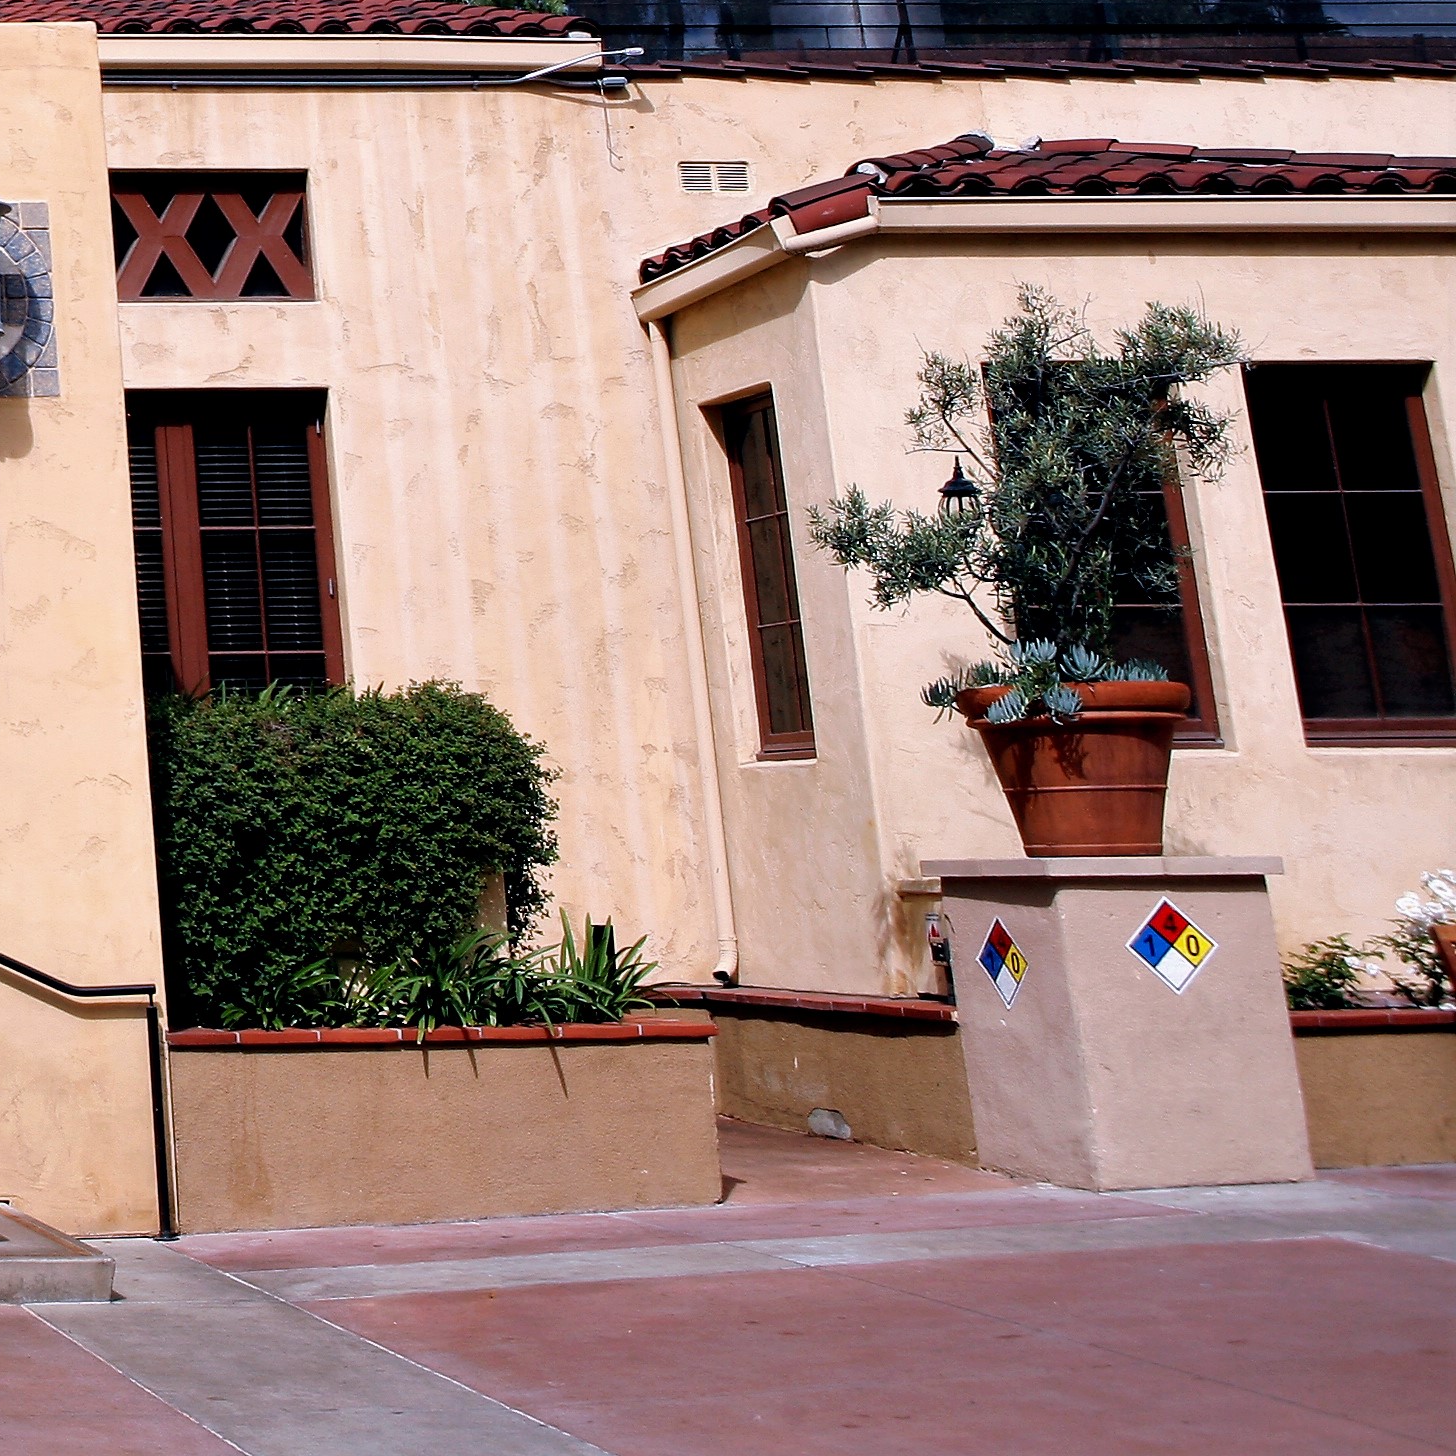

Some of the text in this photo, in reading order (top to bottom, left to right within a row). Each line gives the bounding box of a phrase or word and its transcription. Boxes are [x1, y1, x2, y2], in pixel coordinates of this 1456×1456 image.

[1163, 913, 1178, 934] 4
[1143, 934, 1200, 957] 1 0
[1010, 952, 1020, 974] 0
